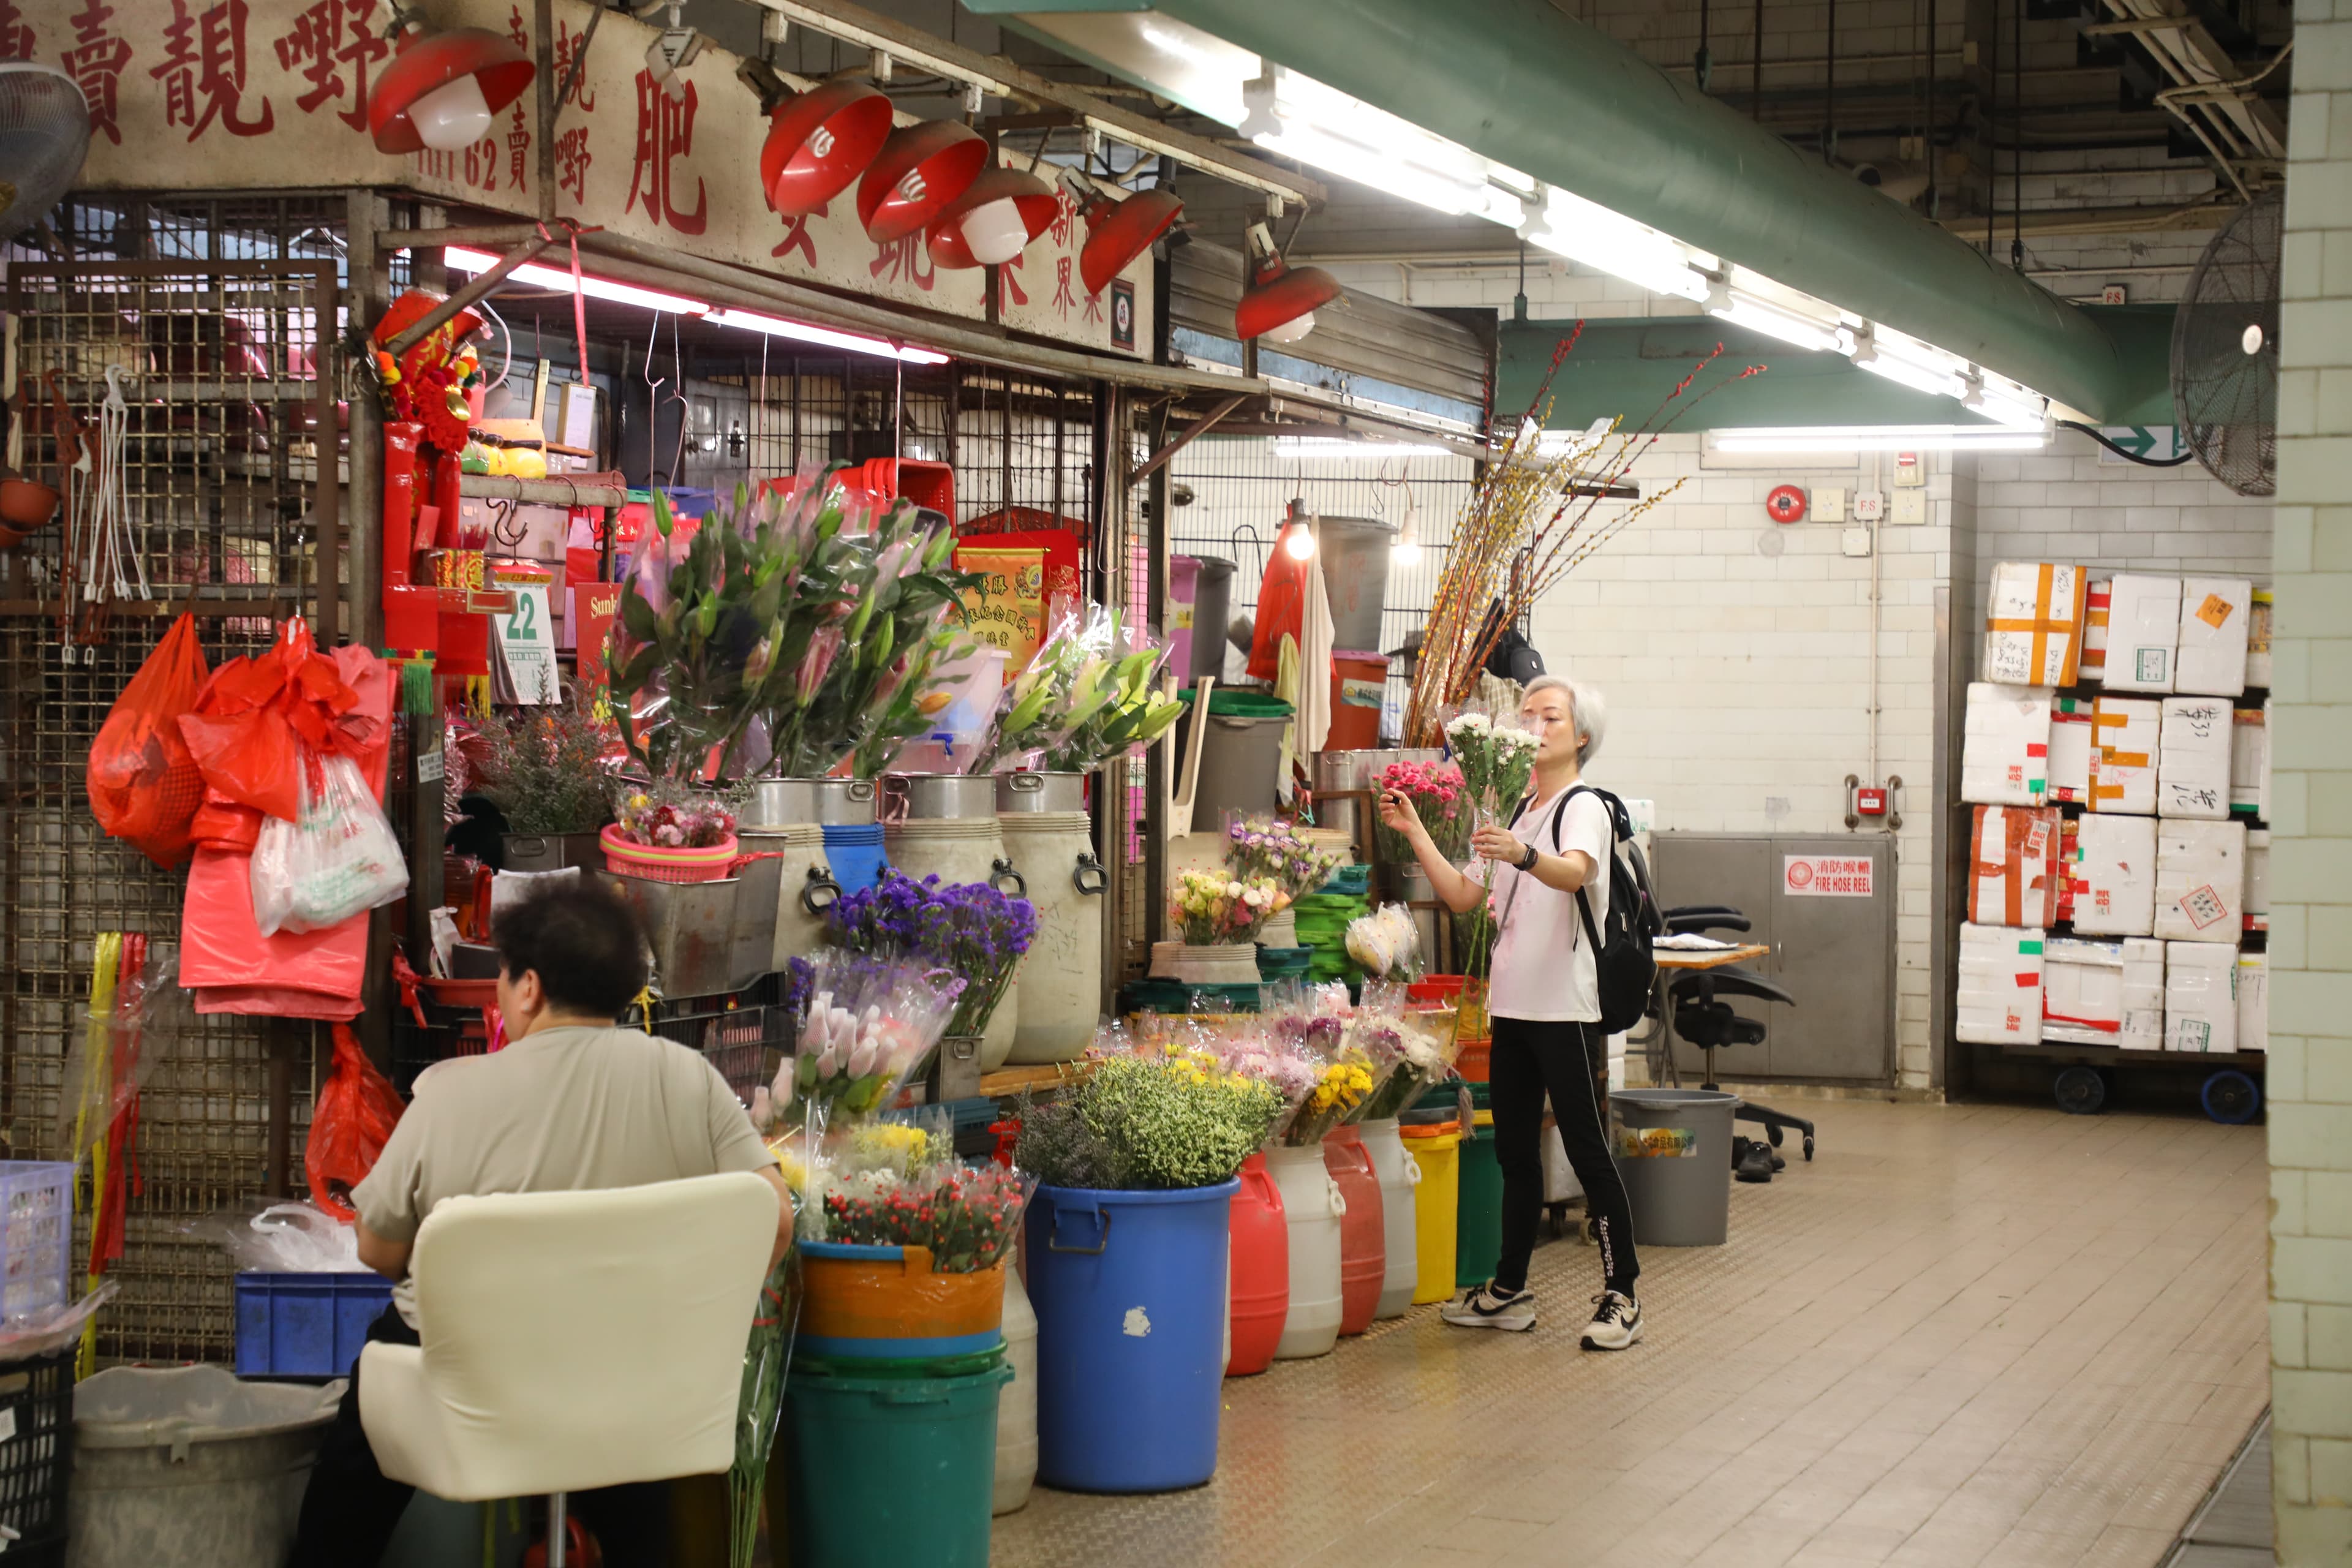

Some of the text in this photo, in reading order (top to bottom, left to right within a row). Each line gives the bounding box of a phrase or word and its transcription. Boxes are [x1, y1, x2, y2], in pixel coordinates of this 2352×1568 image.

[507, 592, 537, 639] 22
[1815, 876, 1871, 892] FIRE HOSE REEL
